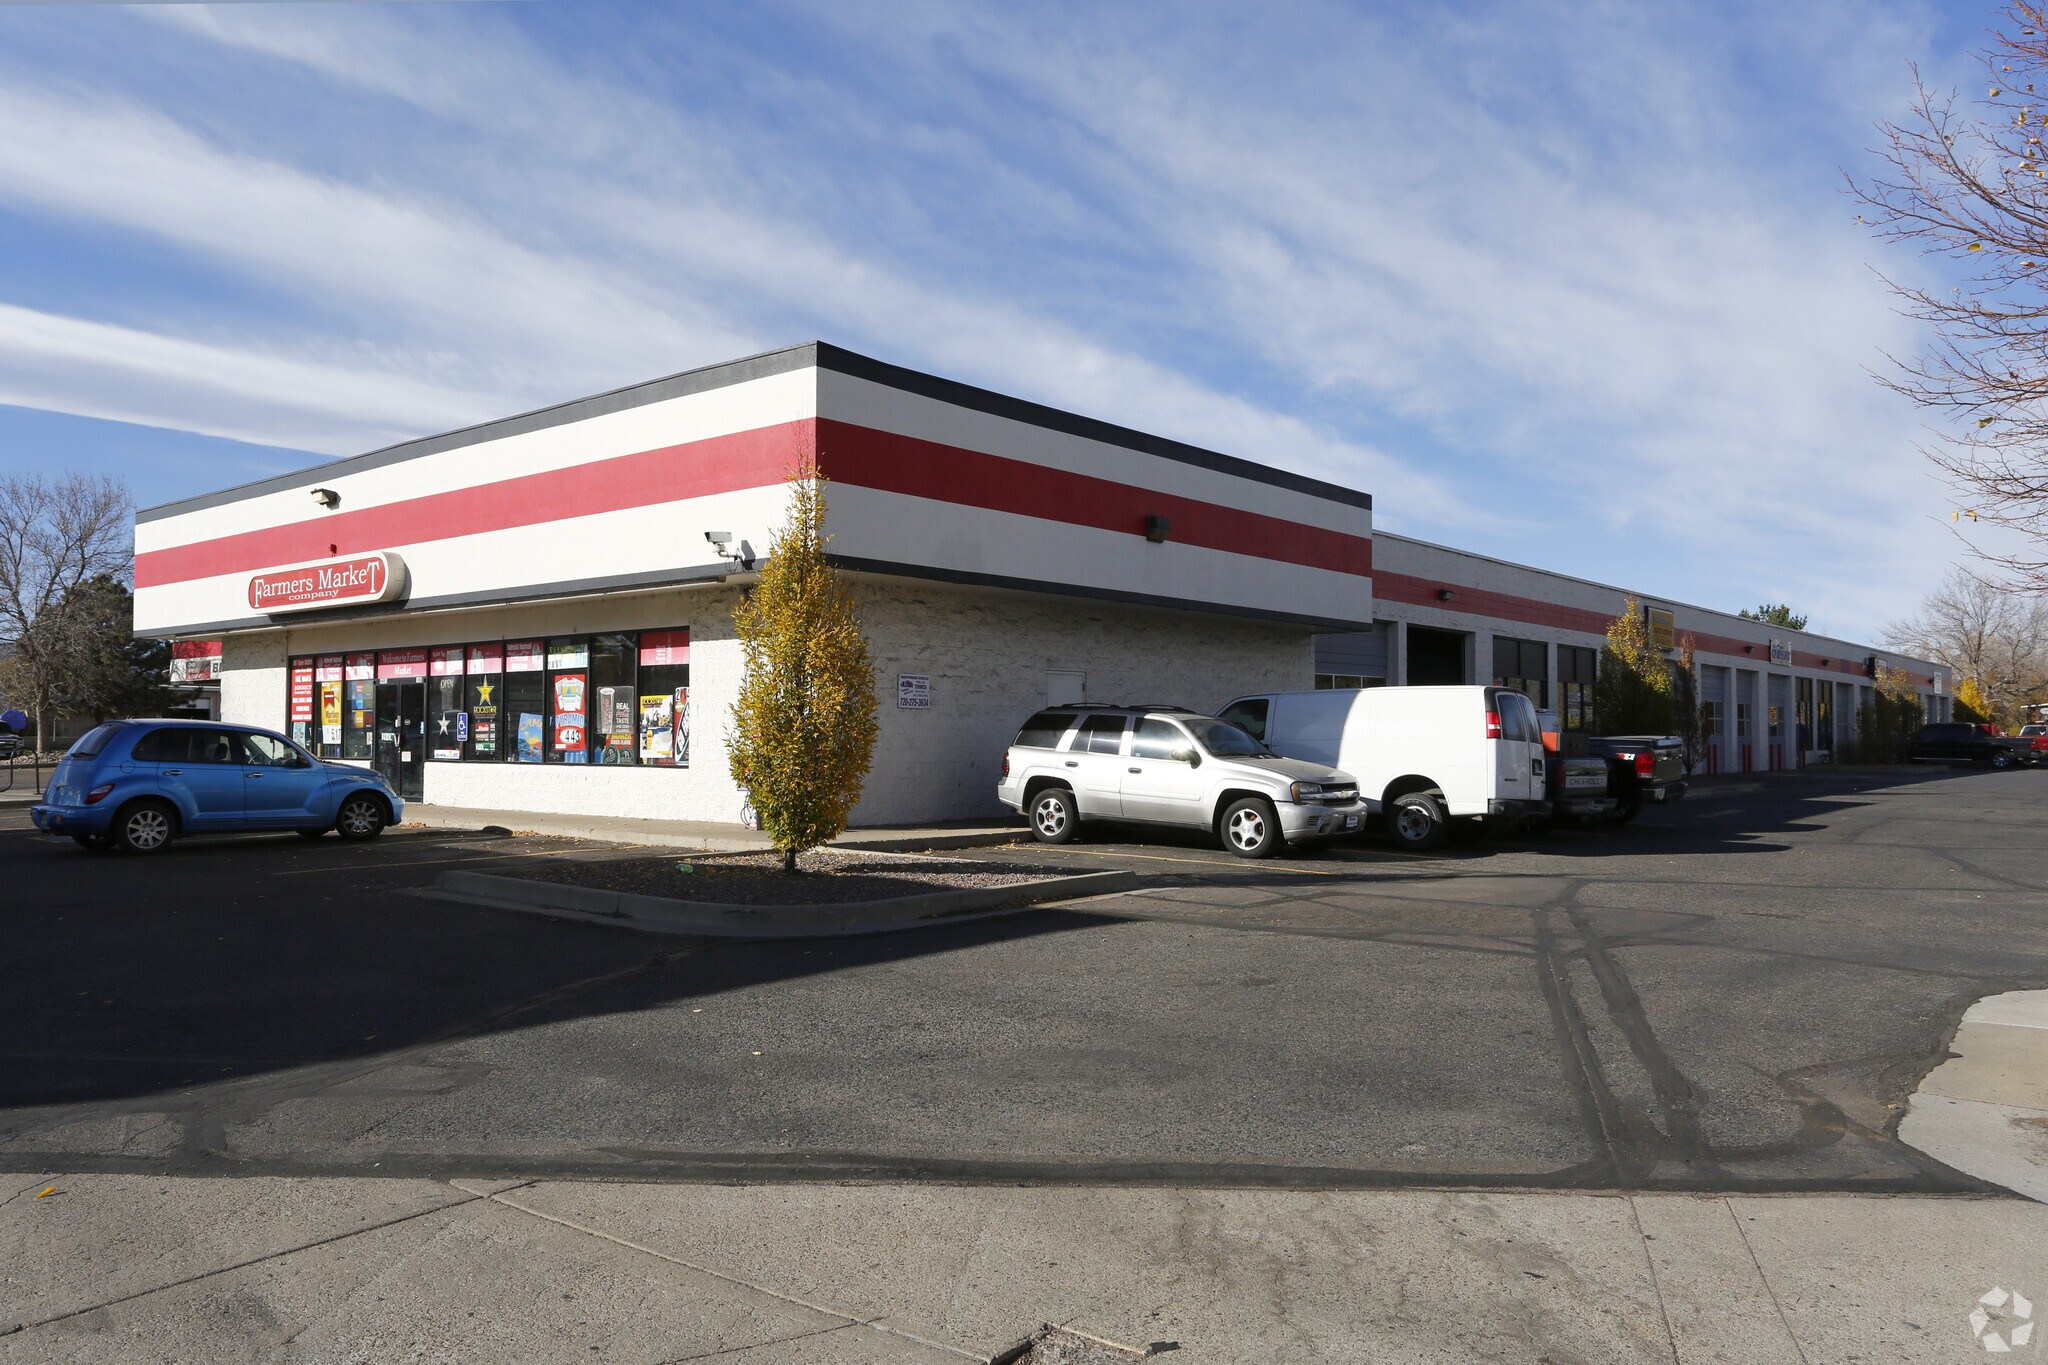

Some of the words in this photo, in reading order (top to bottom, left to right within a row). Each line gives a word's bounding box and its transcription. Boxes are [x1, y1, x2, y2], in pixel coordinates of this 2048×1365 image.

[254, 577, 313, 607] Farmers
[288, 589, 339, 601] company
[382, 653, 401, 663] Welcome
[407, 652, 425, 662] Farmers
[394, 665, 412, 675] Market
[440, 679, 454, 689] OPEN
[474, 706, 497, 714] ROCKSTAR
[616, 702, 630, 710] REAL
[555, 712, 585, 729] PYRAMID
[1570, 777, 1604, 786] CHEVROLET
